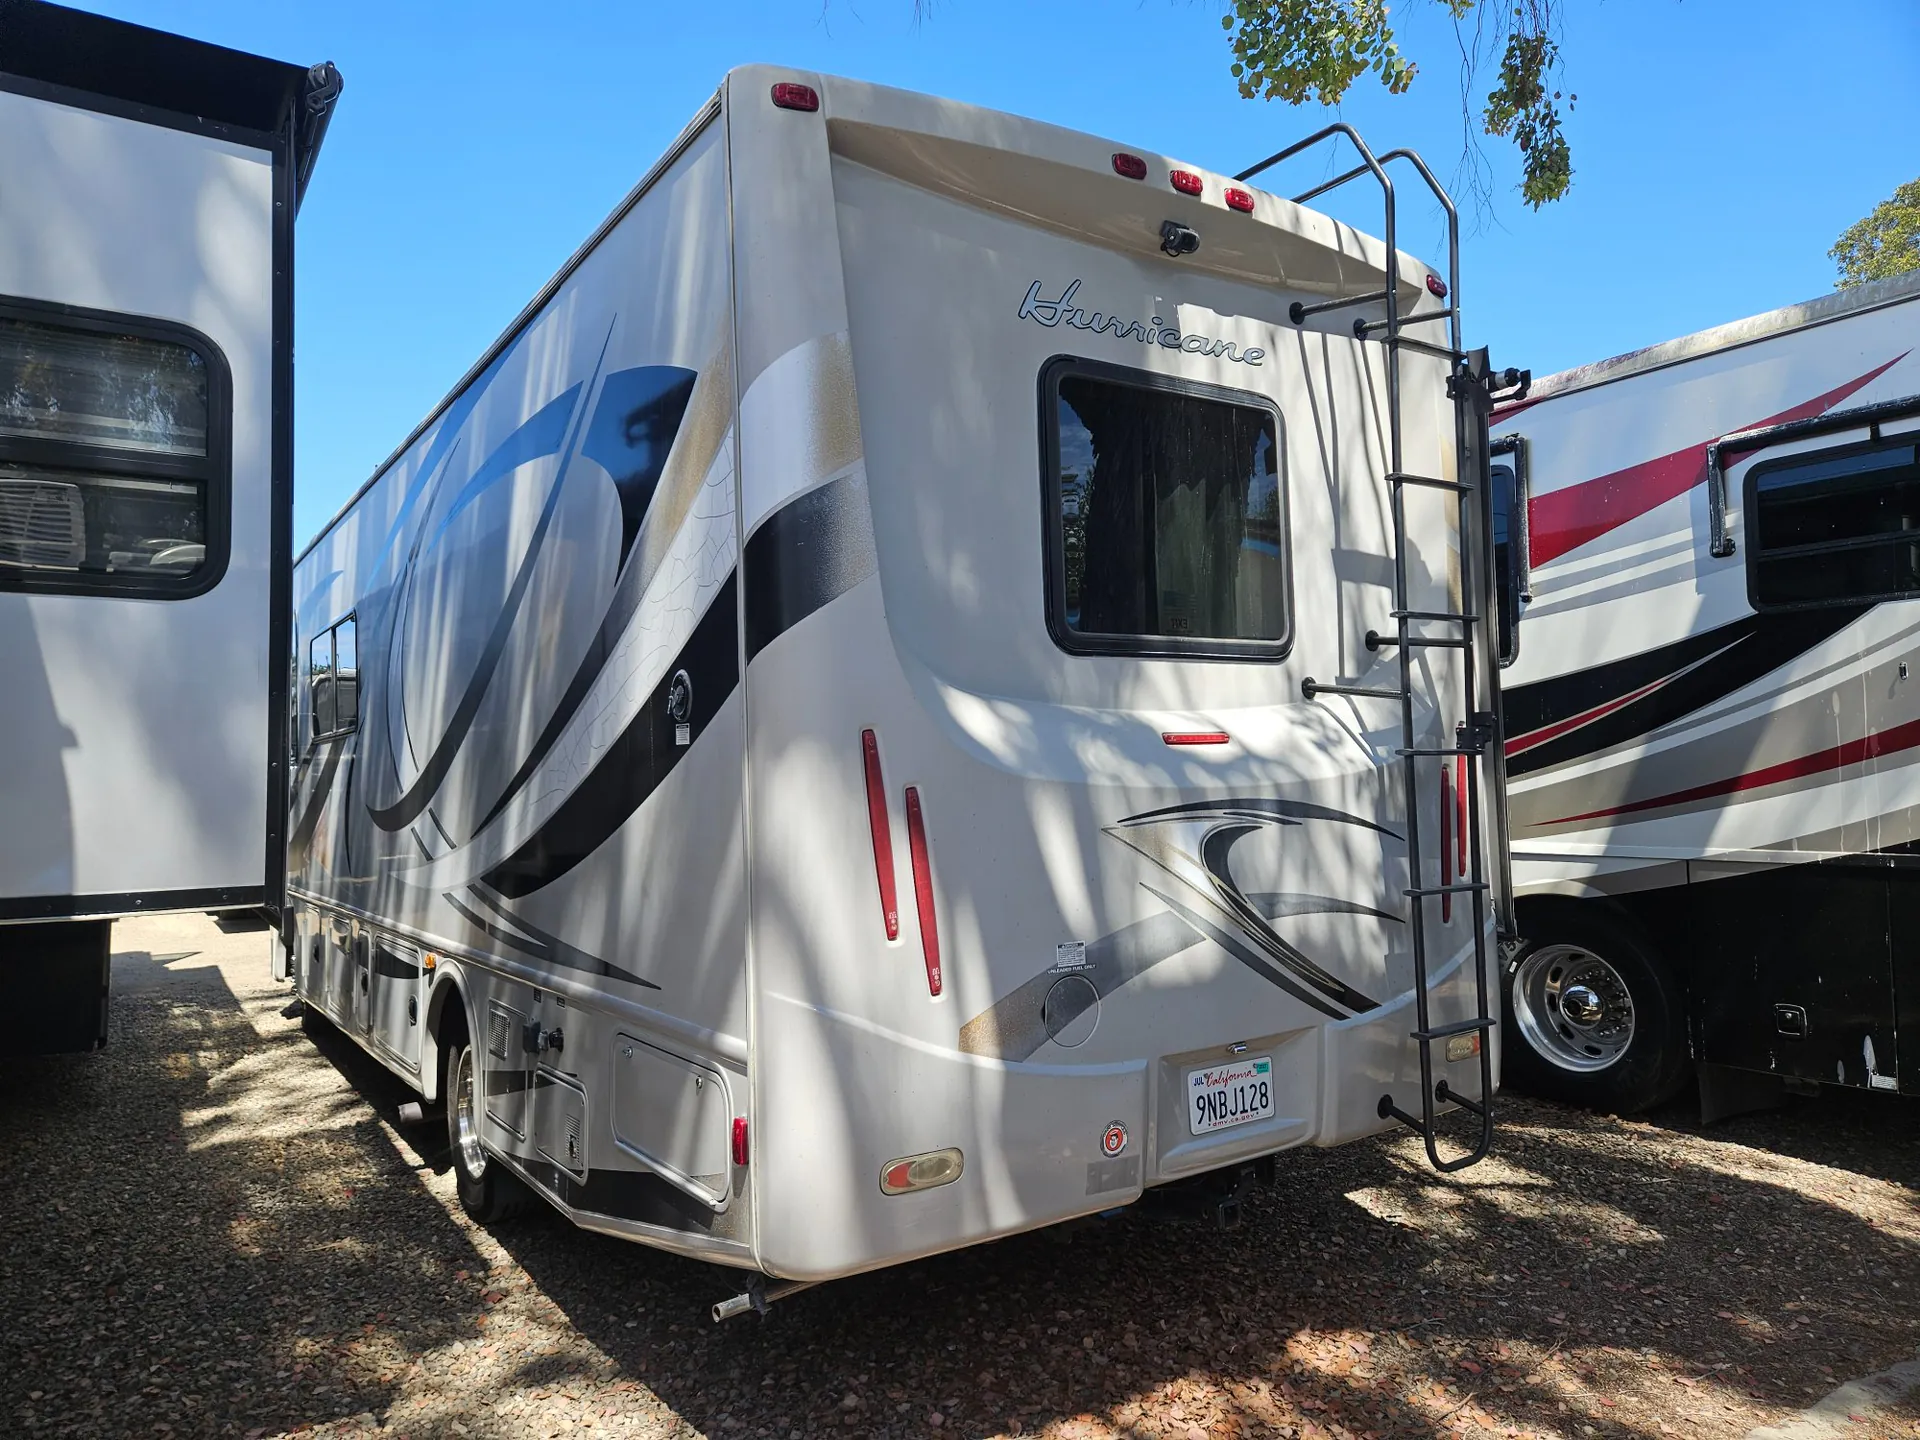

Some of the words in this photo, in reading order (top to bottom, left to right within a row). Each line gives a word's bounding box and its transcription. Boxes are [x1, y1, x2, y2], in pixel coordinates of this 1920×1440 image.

[1018, 279, 1265, 366] Hurricane
[1194, 1076, 1204, 1086] JUL
[1206, 1069, 1257, 1087] California
[1196, 1081, 1269, 1125] 9NBJ128
[1212, 1113, 1255, 1127] dmv.ca.gov
